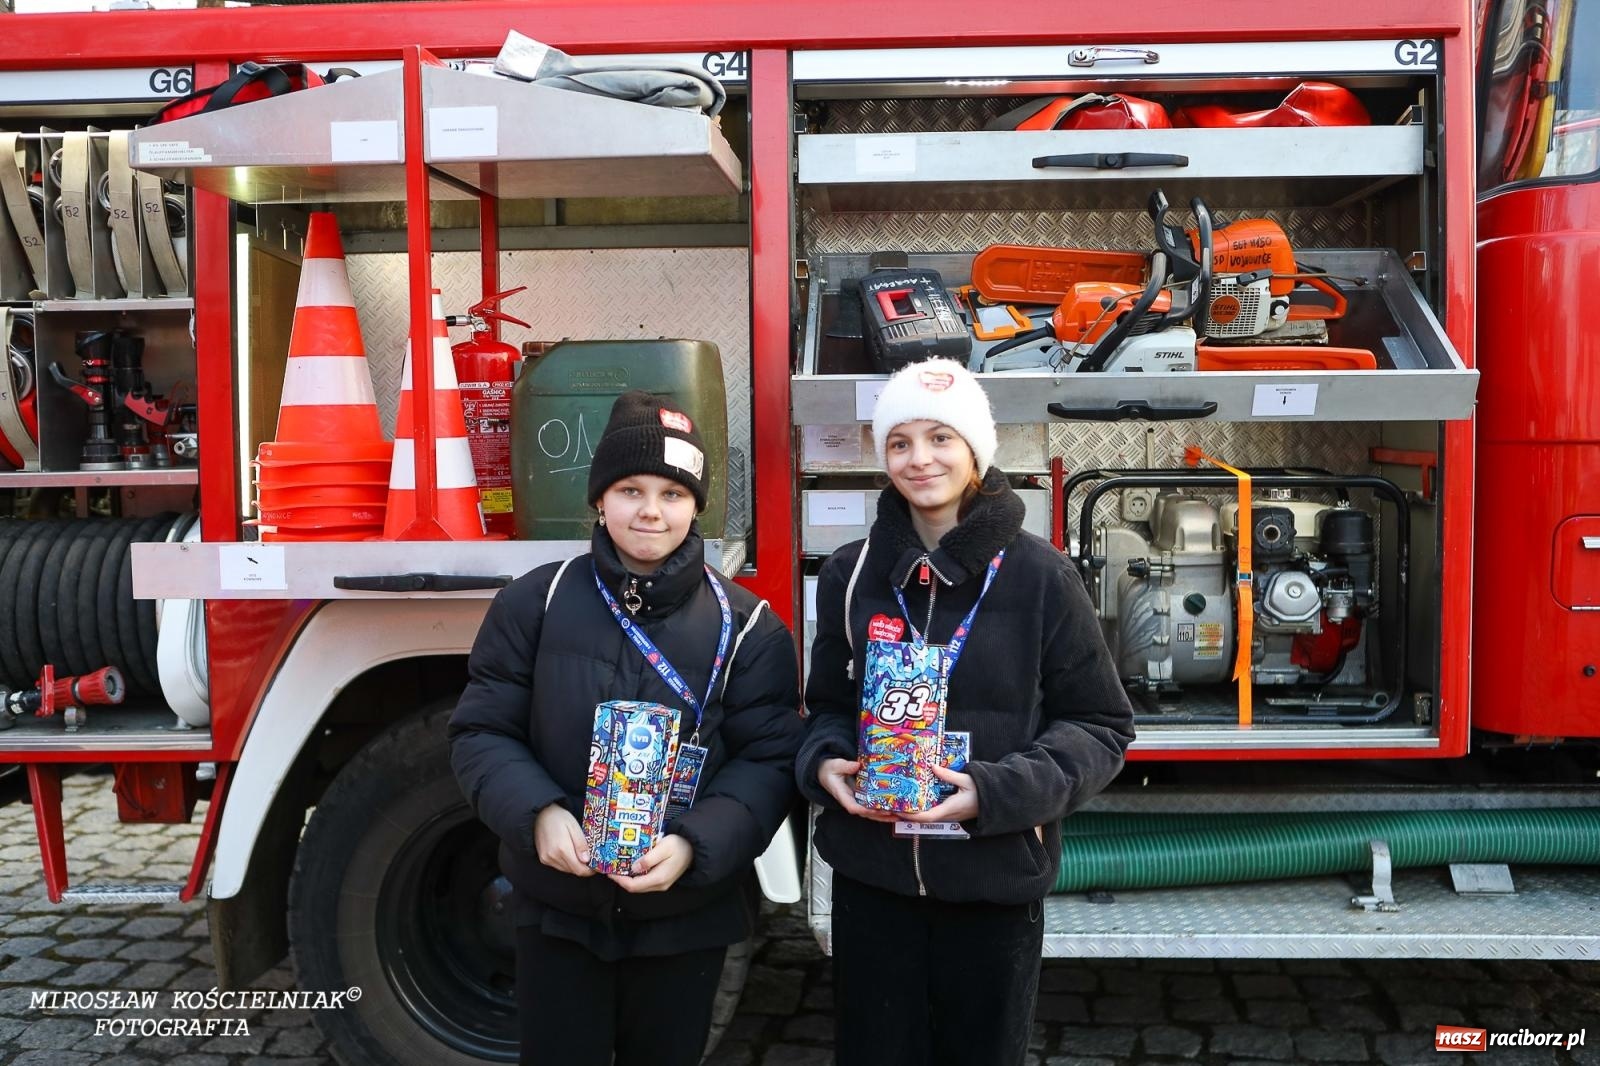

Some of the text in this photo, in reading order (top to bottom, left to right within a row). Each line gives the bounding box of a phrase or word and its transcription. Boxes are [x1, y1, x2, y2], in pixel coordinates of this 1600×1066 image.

[1394, 39, 1438, 66] G2
[702, 52, 747, 77] G4
[149, 68, 192, 94] G6
[65, 206, 80, 217] 52
[145, 202, 160, 213] 52
[114, 209, 129, 219] 52
[23, 236, 40, 247] 52
[1154, 351, 1185, 359] STIHL
[878, 684, 931, 723] 33
[632, 733, 649, 743] tvn
[618, 811, 647, 822] max
